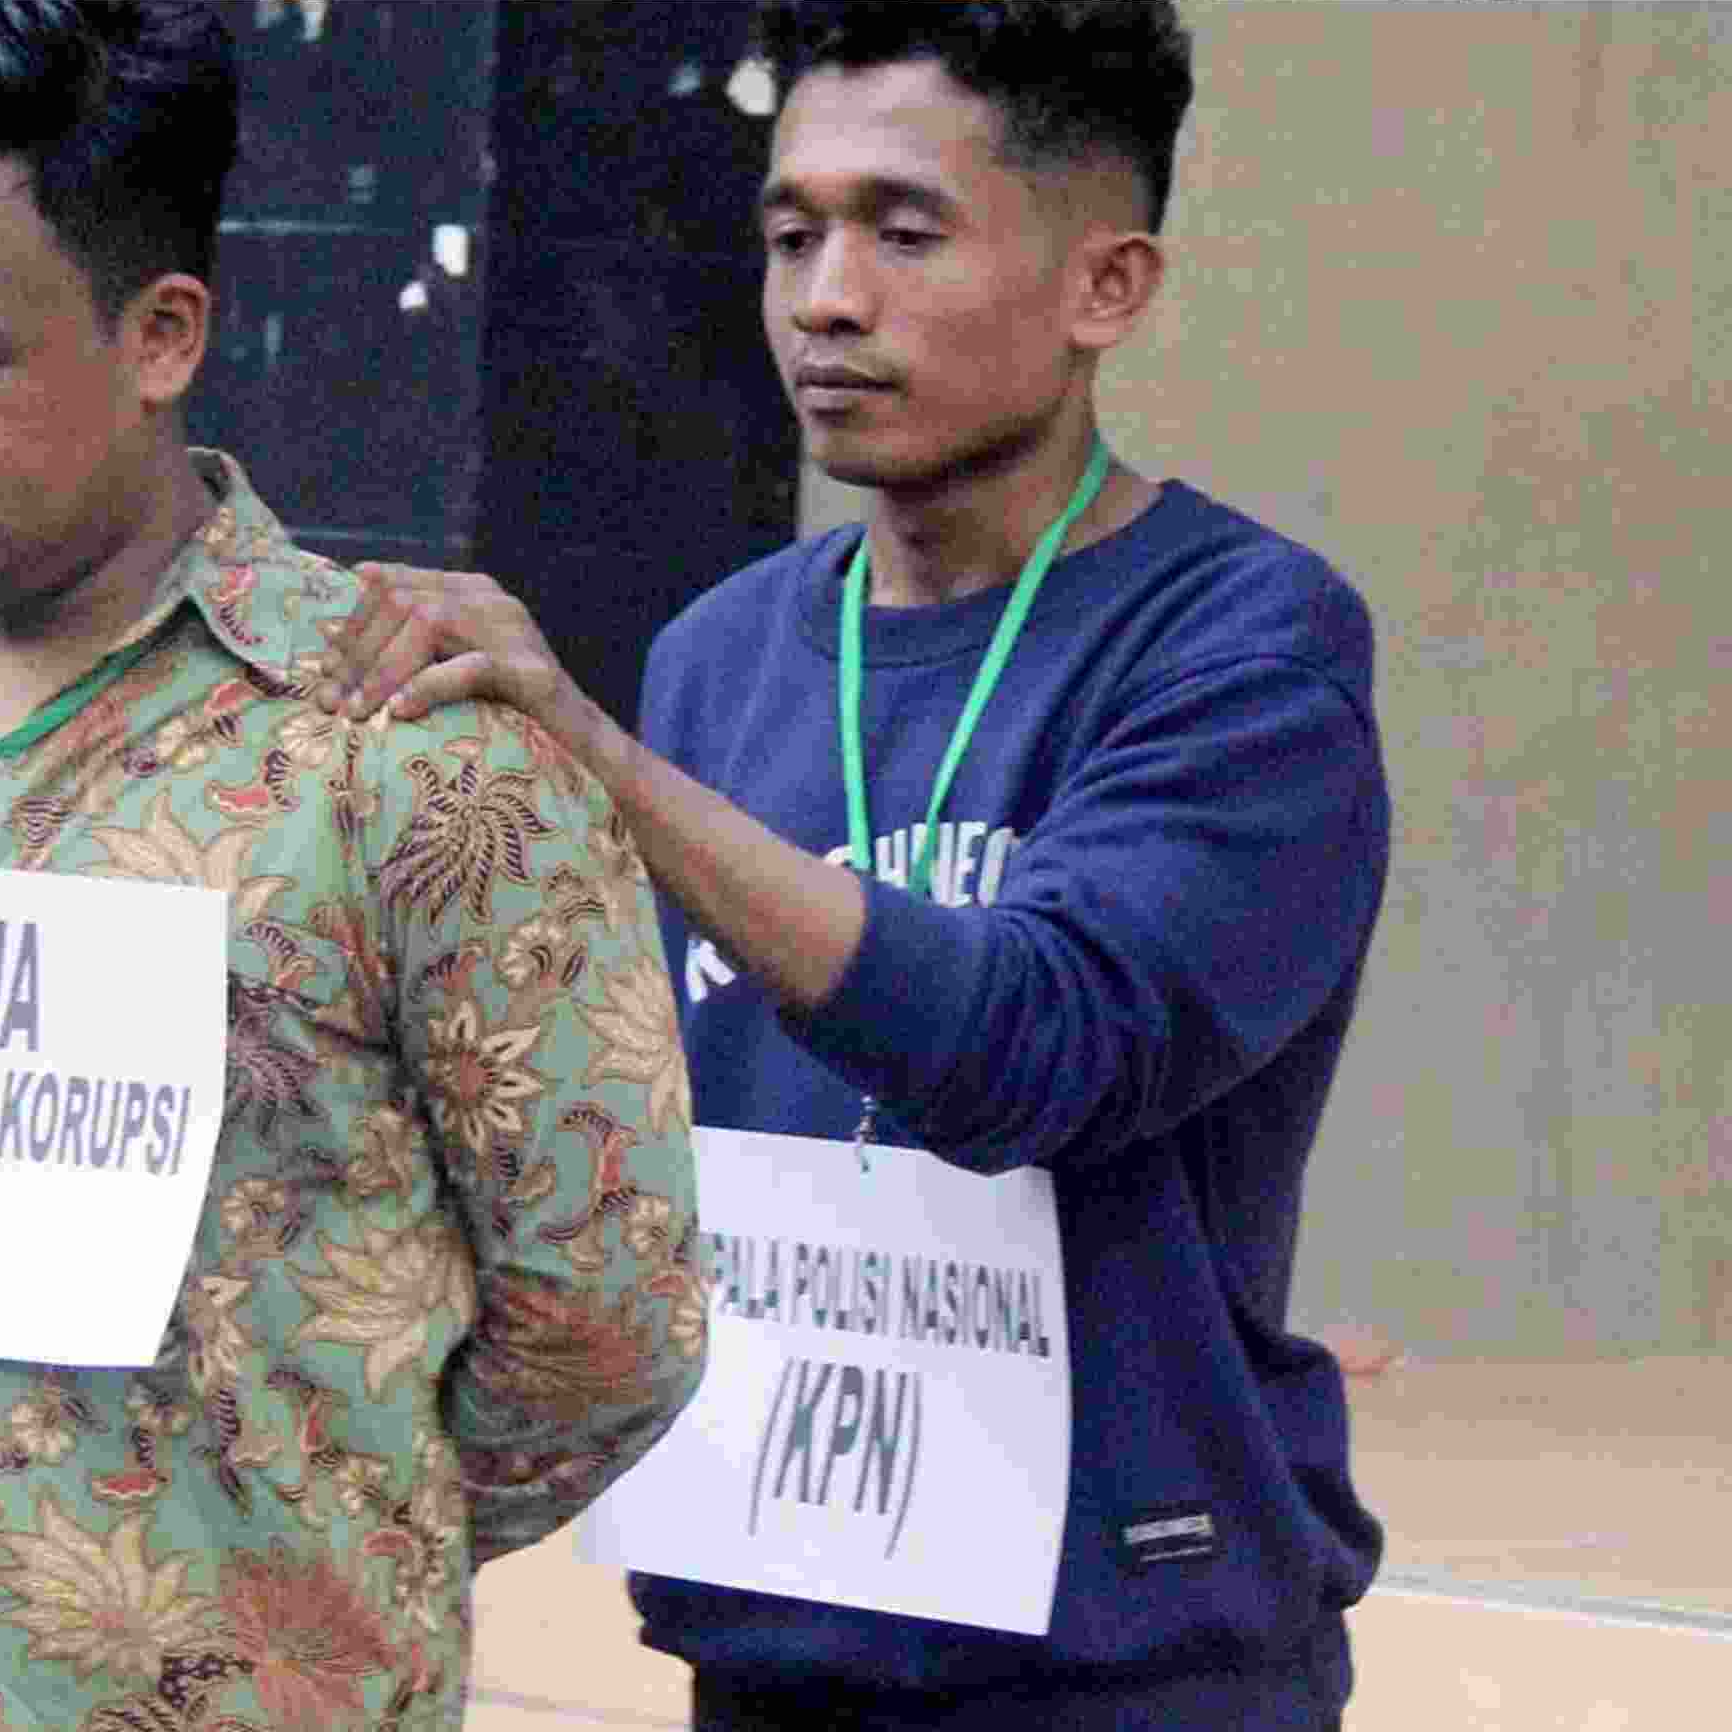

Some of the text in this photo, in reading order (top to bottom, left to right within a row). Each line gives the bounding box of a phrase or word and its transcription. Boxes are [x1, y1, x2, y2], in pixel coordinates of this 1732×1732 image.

[790, 1242, 892, 1338] POLISI
[899, 1255, 1050, 1359] NASIONAL
[747, 1357, 922, 1560] (KPN)
